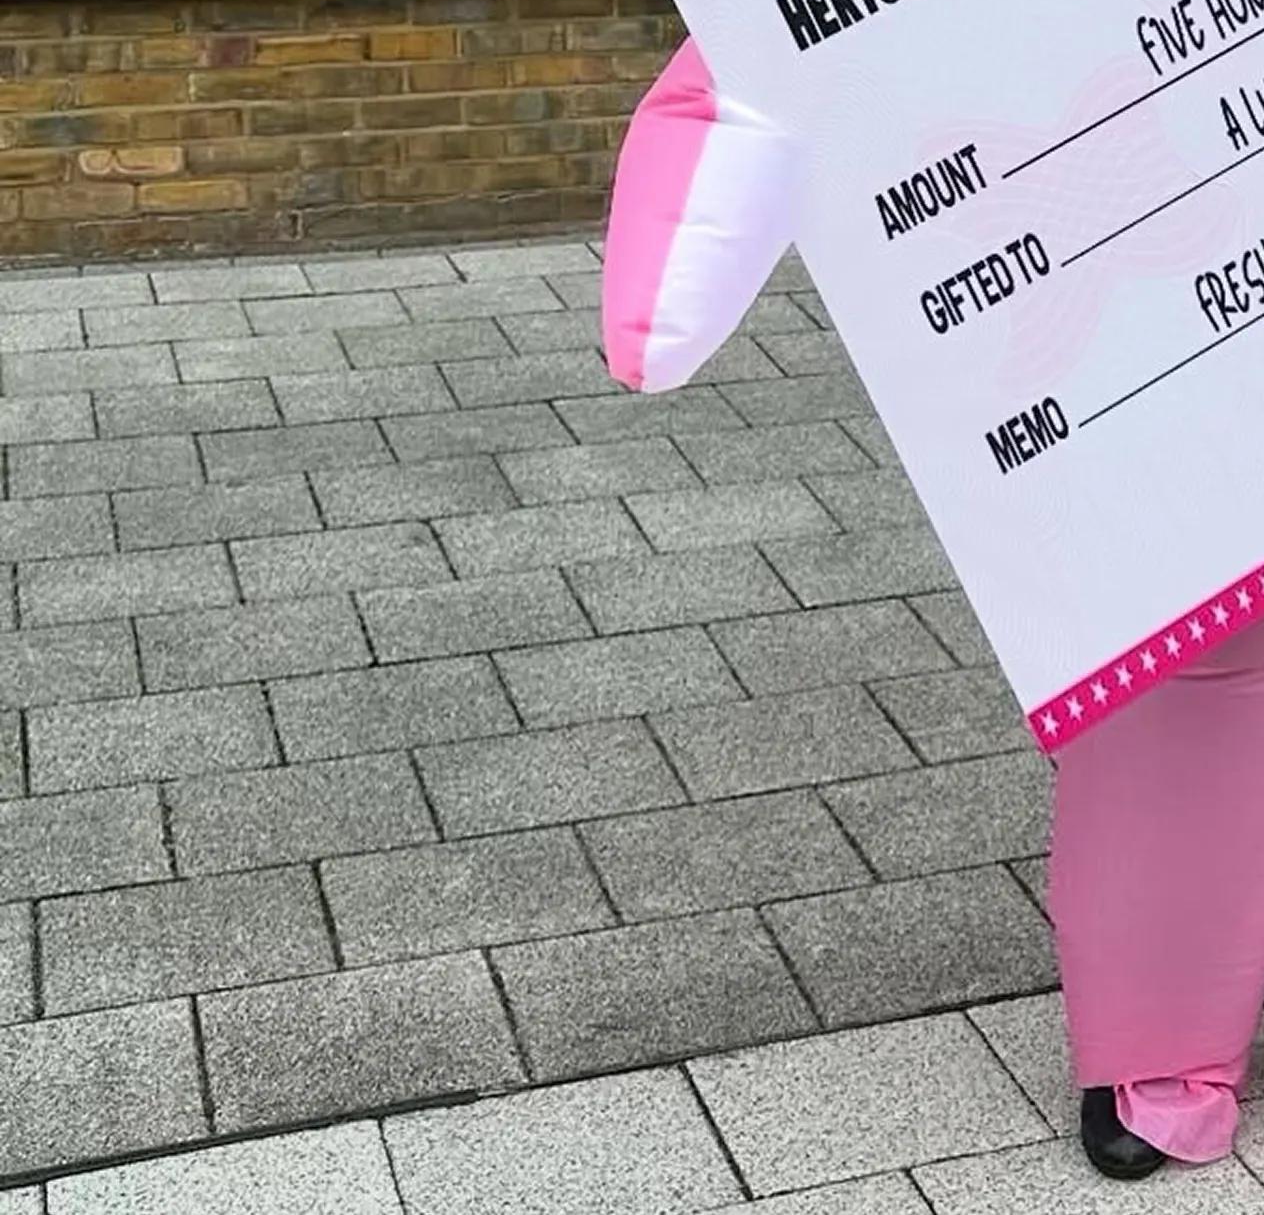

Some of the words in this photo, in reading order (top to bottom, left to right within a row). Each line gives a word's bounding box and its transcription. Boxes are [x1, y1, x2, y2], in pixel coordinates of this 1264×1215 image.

[875, 143, 987, 241] AMOUNT
[920, 252, 1016, 335] GIFTED
[1005, 232, 1051, 285] TO
[1219, 96, 1249, 151] A
[985, 395, 1070, 475] MEMO
